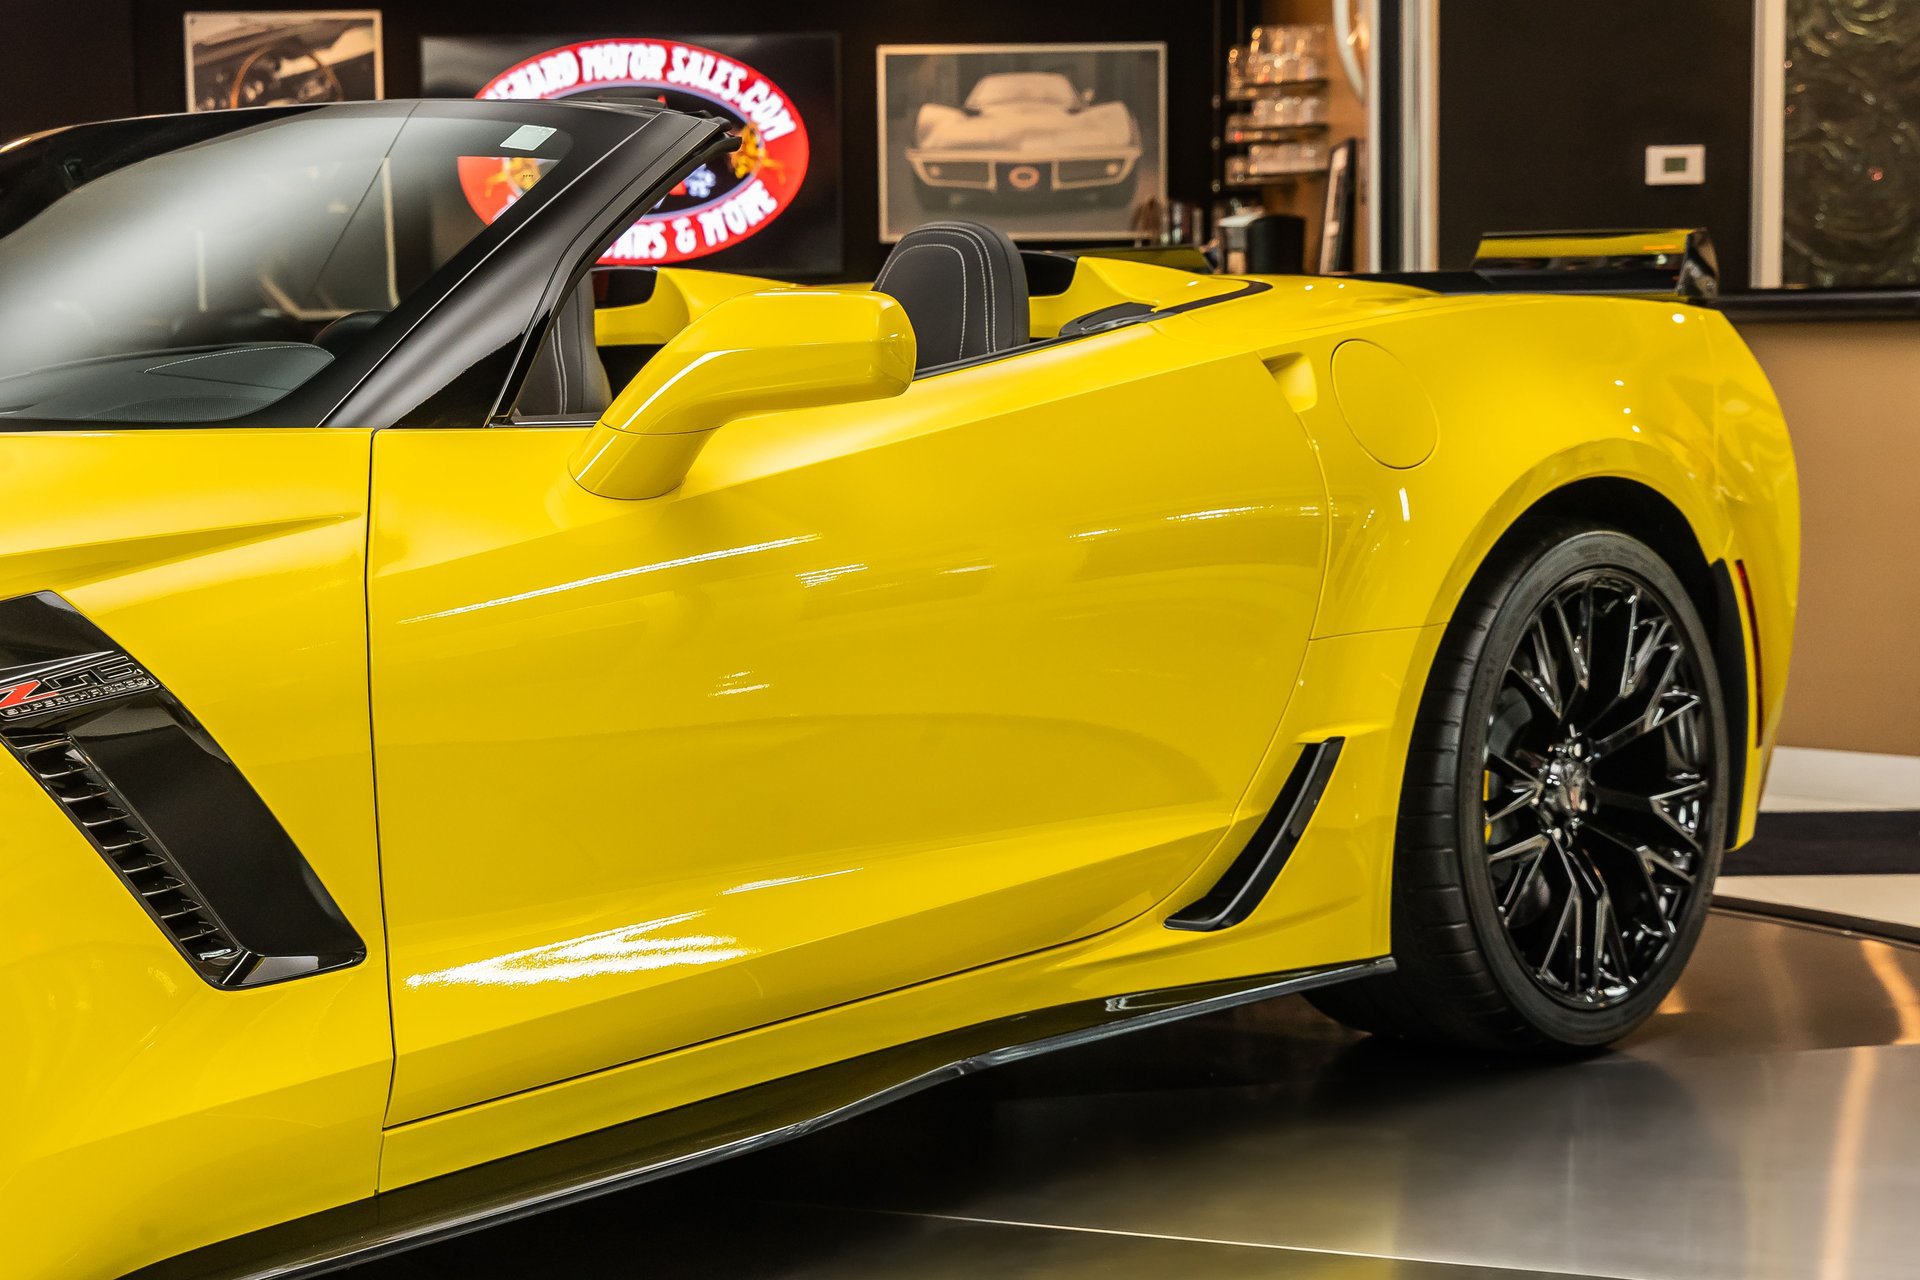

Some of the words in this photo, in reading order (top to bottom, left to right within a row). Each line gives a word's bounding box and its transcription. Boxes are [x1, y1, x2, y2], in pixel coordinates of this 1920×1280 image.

[579, 42, 667, 83] MOTOR
[602, 222, 668, 260] ARS
[672, 216, 697, 254] &
[698, 179, 778, 247] MORE
[6, 676, 150, 716] SUPERCHARGED
